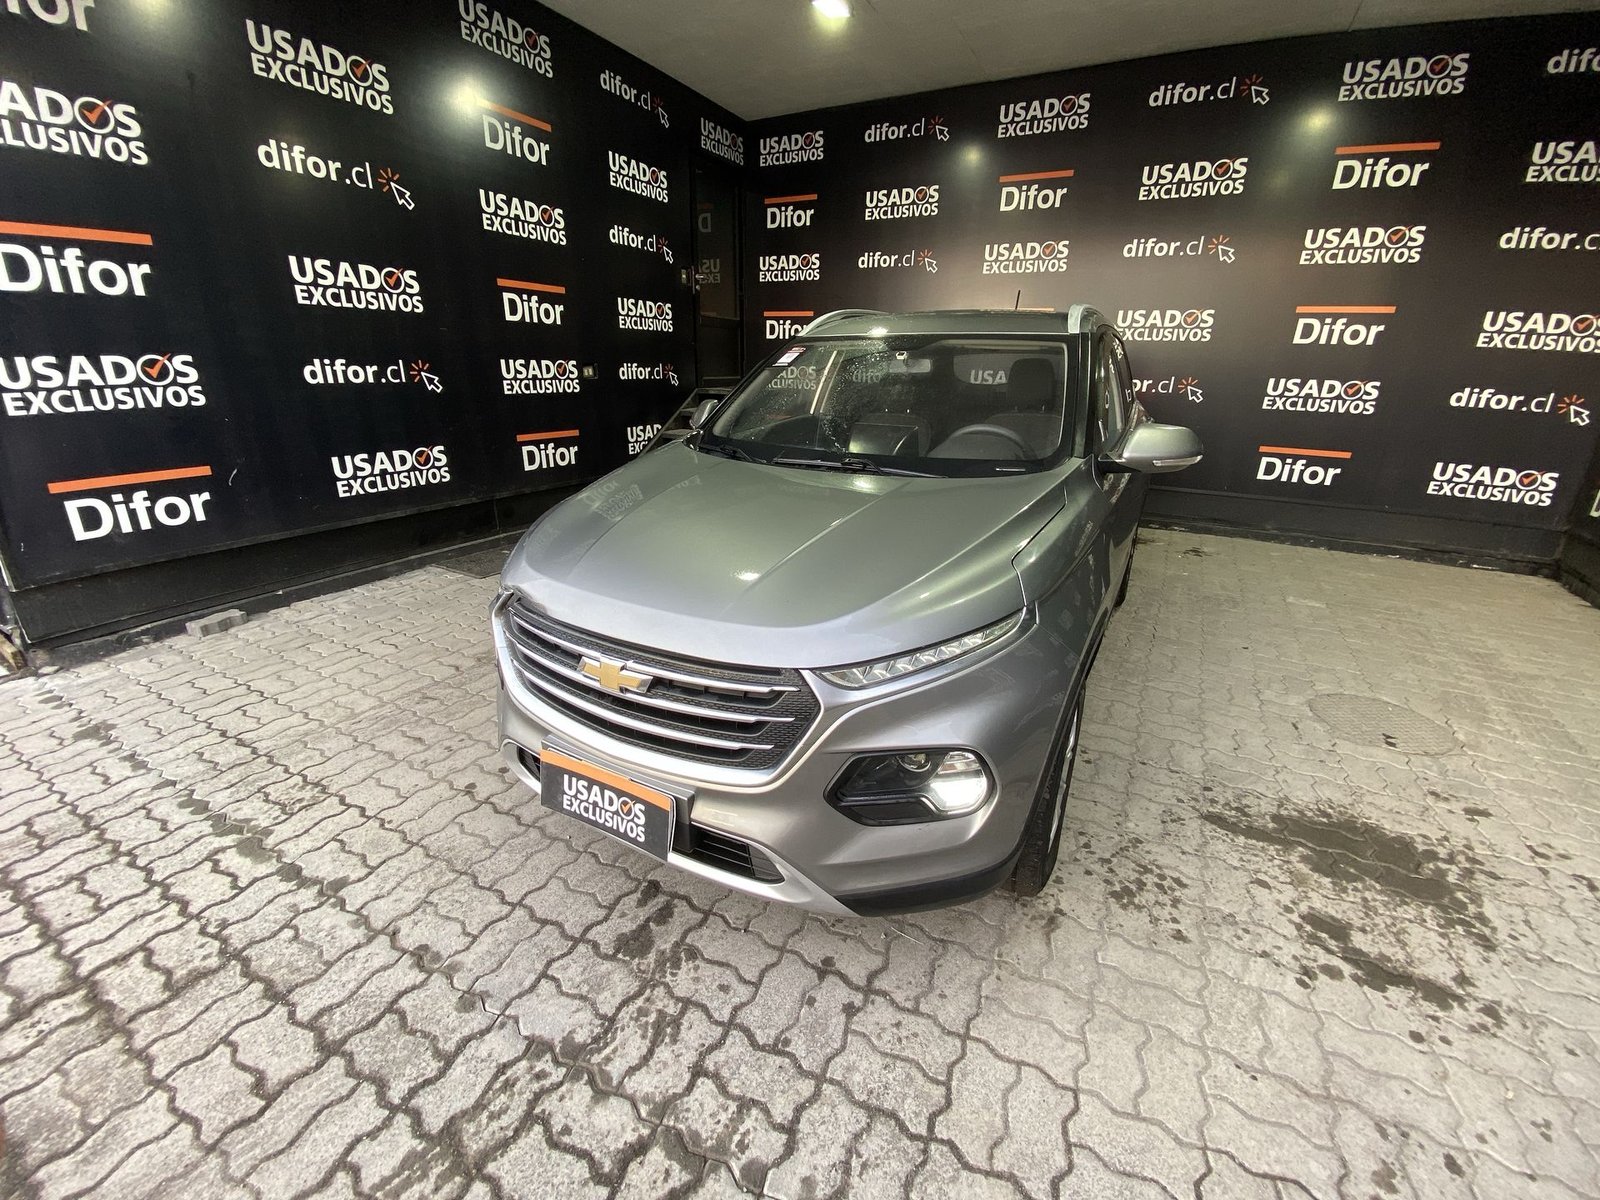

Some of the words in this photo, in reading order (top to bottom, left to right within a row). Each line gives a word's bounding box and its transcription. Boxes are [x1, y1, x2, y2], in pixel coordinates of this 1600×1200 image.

[458, 0, 552, 59] USADOS
[246, 19, 390, 93] USADOS
[460, 20, 553, 79] EXCLUSIVOS
[1343, 53, 1470, 85] USADOS
[251, 52, 393, 115] EXCLUSIVOS
[600, 70, 651, 111] difor.cl
[1148, 77, 1236, 108] difor.cl
[1338, 78, 1465, 102] EXCLUSIVOS
[999, 93, 1091, 123] USADOS
[700, 117, 744, 152] USADOS
[865, 118, 925, 143] difor.cl
[997, 113, 1089, 139] EXCLUSIVOS
[0, 119, 148, 166] LUSIVOS
[482, 114, 550, 166] Difor
[700, 135, 744, 166] EXCLUSIVOS
[760, 130, 824, 154] USADOS
[1532, 141, 1600, 164] USA
[257, 139, 373, 189] difor.cl
[608, 150, 668, 189] USADOS
[760, 148, 824, 167] EXCLUSIVOS
[1142, 158, 1248, 185] USADOS
[1332, 158, 1429, 190] Difor
[609, 171, 669, 203] EXCLUSIVOS
[866, 185, 939, 207] USADOS
[999, 185, 1068, 212] Difor
[1138, 179, 1245, 201] EXCLUSIVOS
[479, 188, 565, 229] USADOS
[767, 206, 814, 229] Difor
[865, 202, 938, 221] EXCLUSIVOS
[482, 213, 567, 246] EXCLUSIVOS
[609, 225, 657, 253] difor.cl
[1304, 226, 1426, 249] USADOS
[1499, 226, 1600, 250] difor.c
[858, 250, 915, 269] difor.cl
[984, 240, 1070, 260] USADOS
[1123, 237, 1204, 259] difor.cl
[1299, 245, 1420, 266] EXCLUSIVOS
[0, 243, 151, 297] Difor
[759, 254, 820, 270] USADOS
[982, 256, 1068, 274] EXCLUSIVOS
[288, 255, 420, 299] USADOS
[759, 270, 820, 282] EXCLUSIVOS
[294, 284, 423, 313] EXCLUSIVOS
[502, 292, 564, 325] Difor
[617, 297, 672, 320] USADOS
[618, 316, 674, 332] EXCLUSIVOS
[766, 320, 806, 339] Difo
[1117, 309, 1215, 328] USADOS
[1292, 317, 1384, 345] Difor
[1482, 311, 1600, 336] USADO
[0, 354, 199, 389] USADOS
[303, 359, 406, 386] difor.cl
[500, 359, 578, 380] USADOS
[619, 362, 663, 380] difor.cl
[503, 379, 580, 395] EXCLUSIVOS
[1267, 378, 1381, 401] USADOS
[1449, 387, 1555, 413] difor.cl
[2, 385, 207, 417] EXCLUSIVOS
[1262, 397, 1377, 415] EXCLUSIVOS
[331, 445, 448, 480] USADOS
[521, 443, 579, 471] Difor
[336, 467, 451, 498] EXCLUSIVOS
[1257, 457, 1341, 486] Difor
[1433, 462, 1559, 492] USADOS
[1426, 481, 1553, 507] EXCLUSIVOS
[64, 489, 212, 541] Difor
[563, 774, 646, 826] USADOS
[563, 795, 646, 843] EXCLUSIVOS
